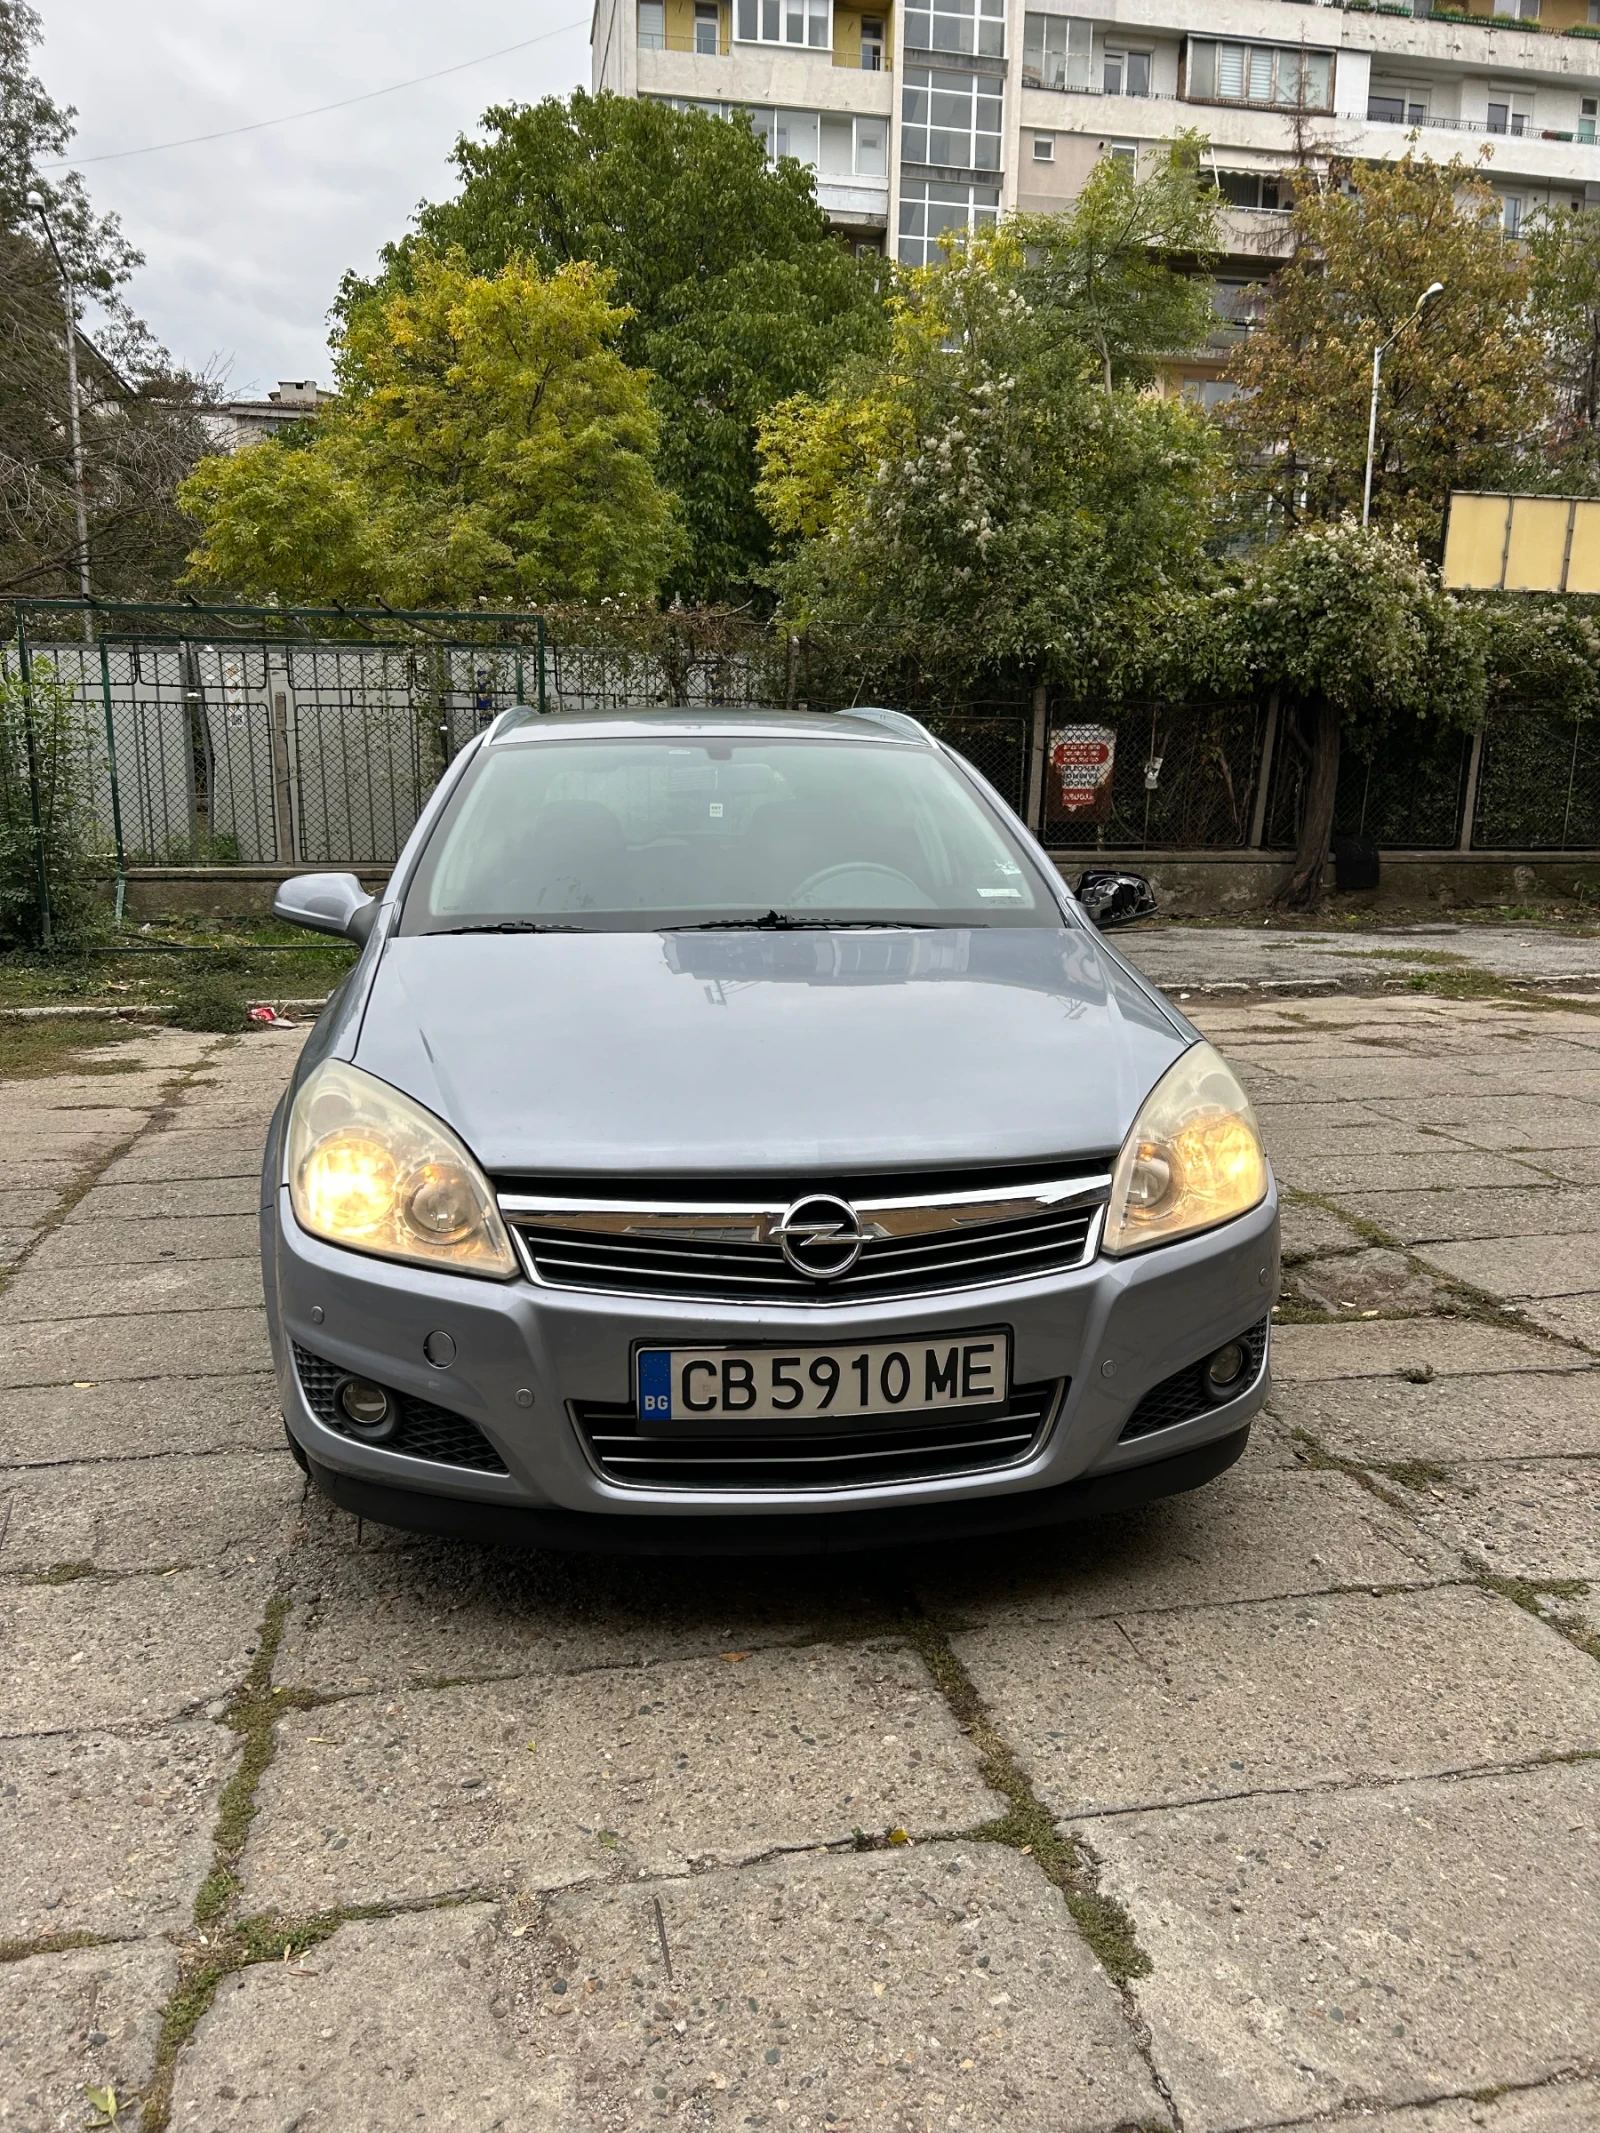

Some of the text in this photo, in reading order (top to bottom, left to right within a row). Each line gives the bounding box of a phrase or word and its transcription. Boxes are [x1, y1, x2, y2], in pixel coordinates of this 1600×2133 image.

[681, 1343, 995, 1412] CB 5910 ME
[644, 1395, 668, 1411] BG
